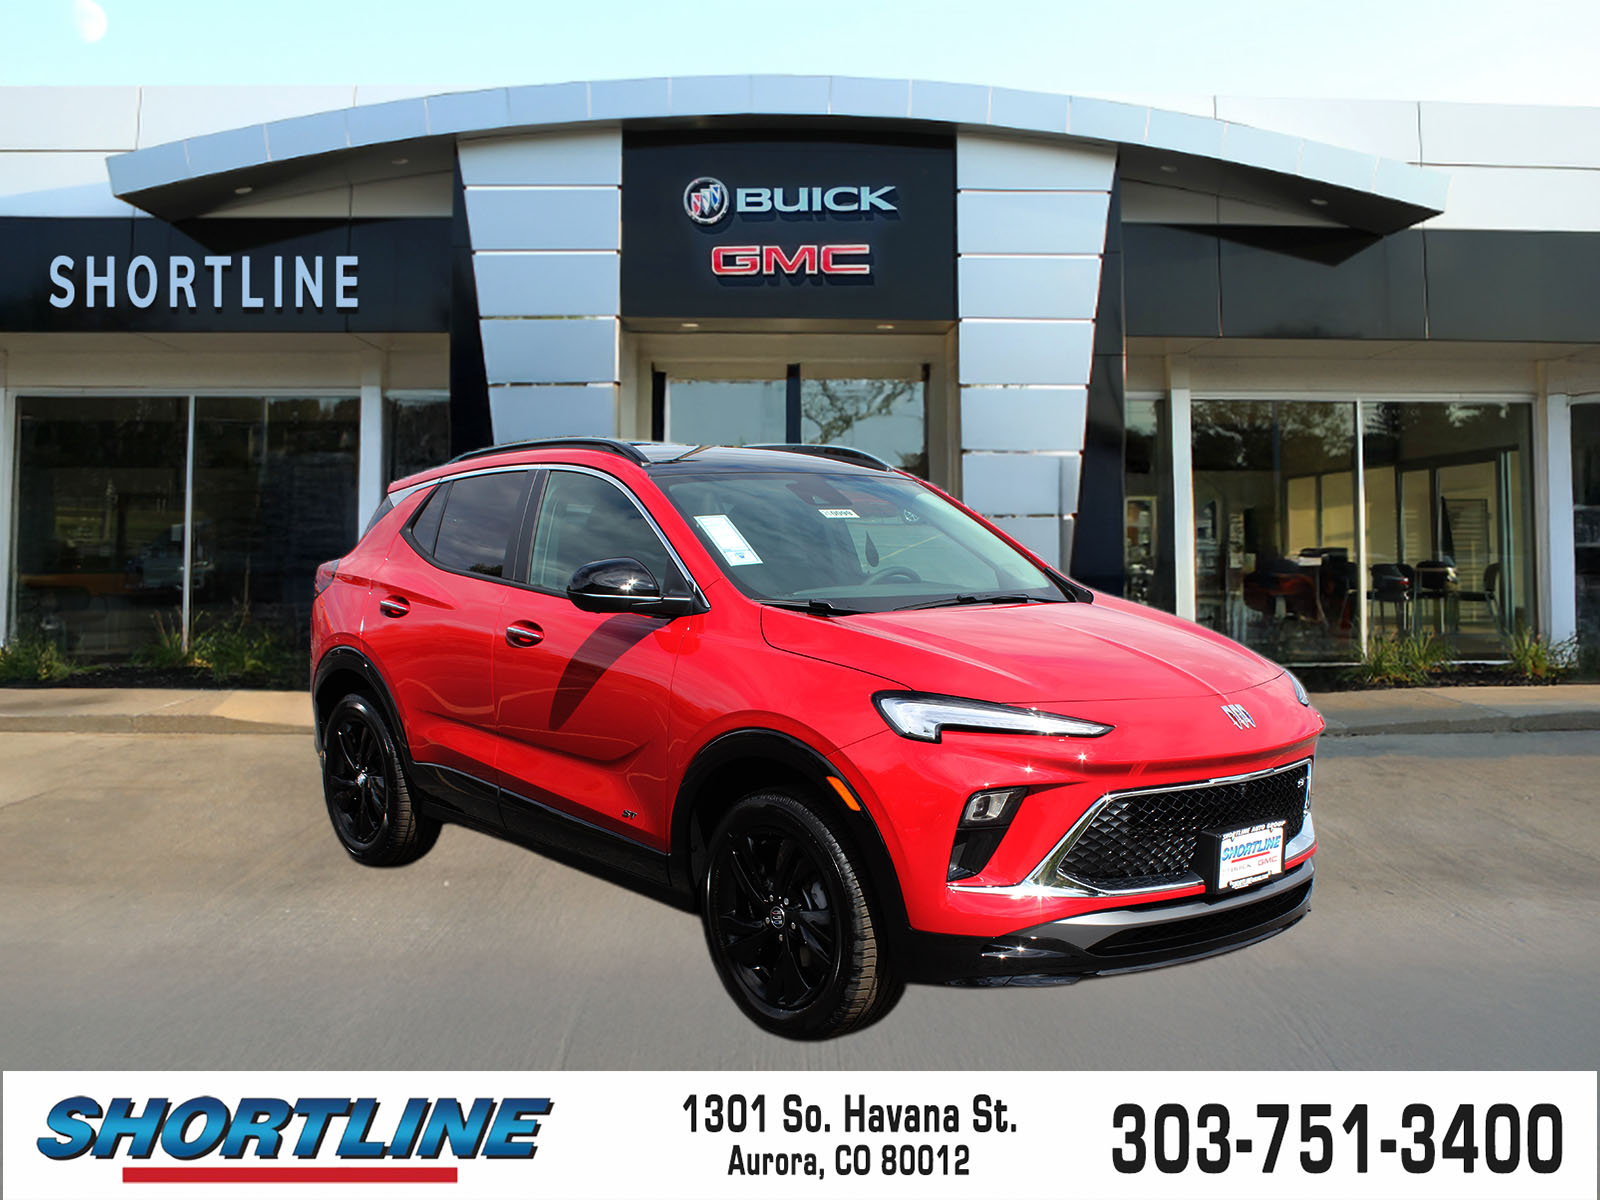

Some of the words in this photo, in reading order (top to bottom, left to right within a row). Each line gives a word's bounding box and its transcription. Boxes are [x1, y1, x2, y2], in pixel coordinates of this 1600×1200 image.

[736, 185, 898, 213] BUICK
[711, 243, 870, 275] GMC
[49, 255, 359, 308] SHORTLINE
[622, 809, 638, 820] ST
[1222, 835, 1282, 861] SHORTLINE
[1257, 855, 1278, 866] GMC
